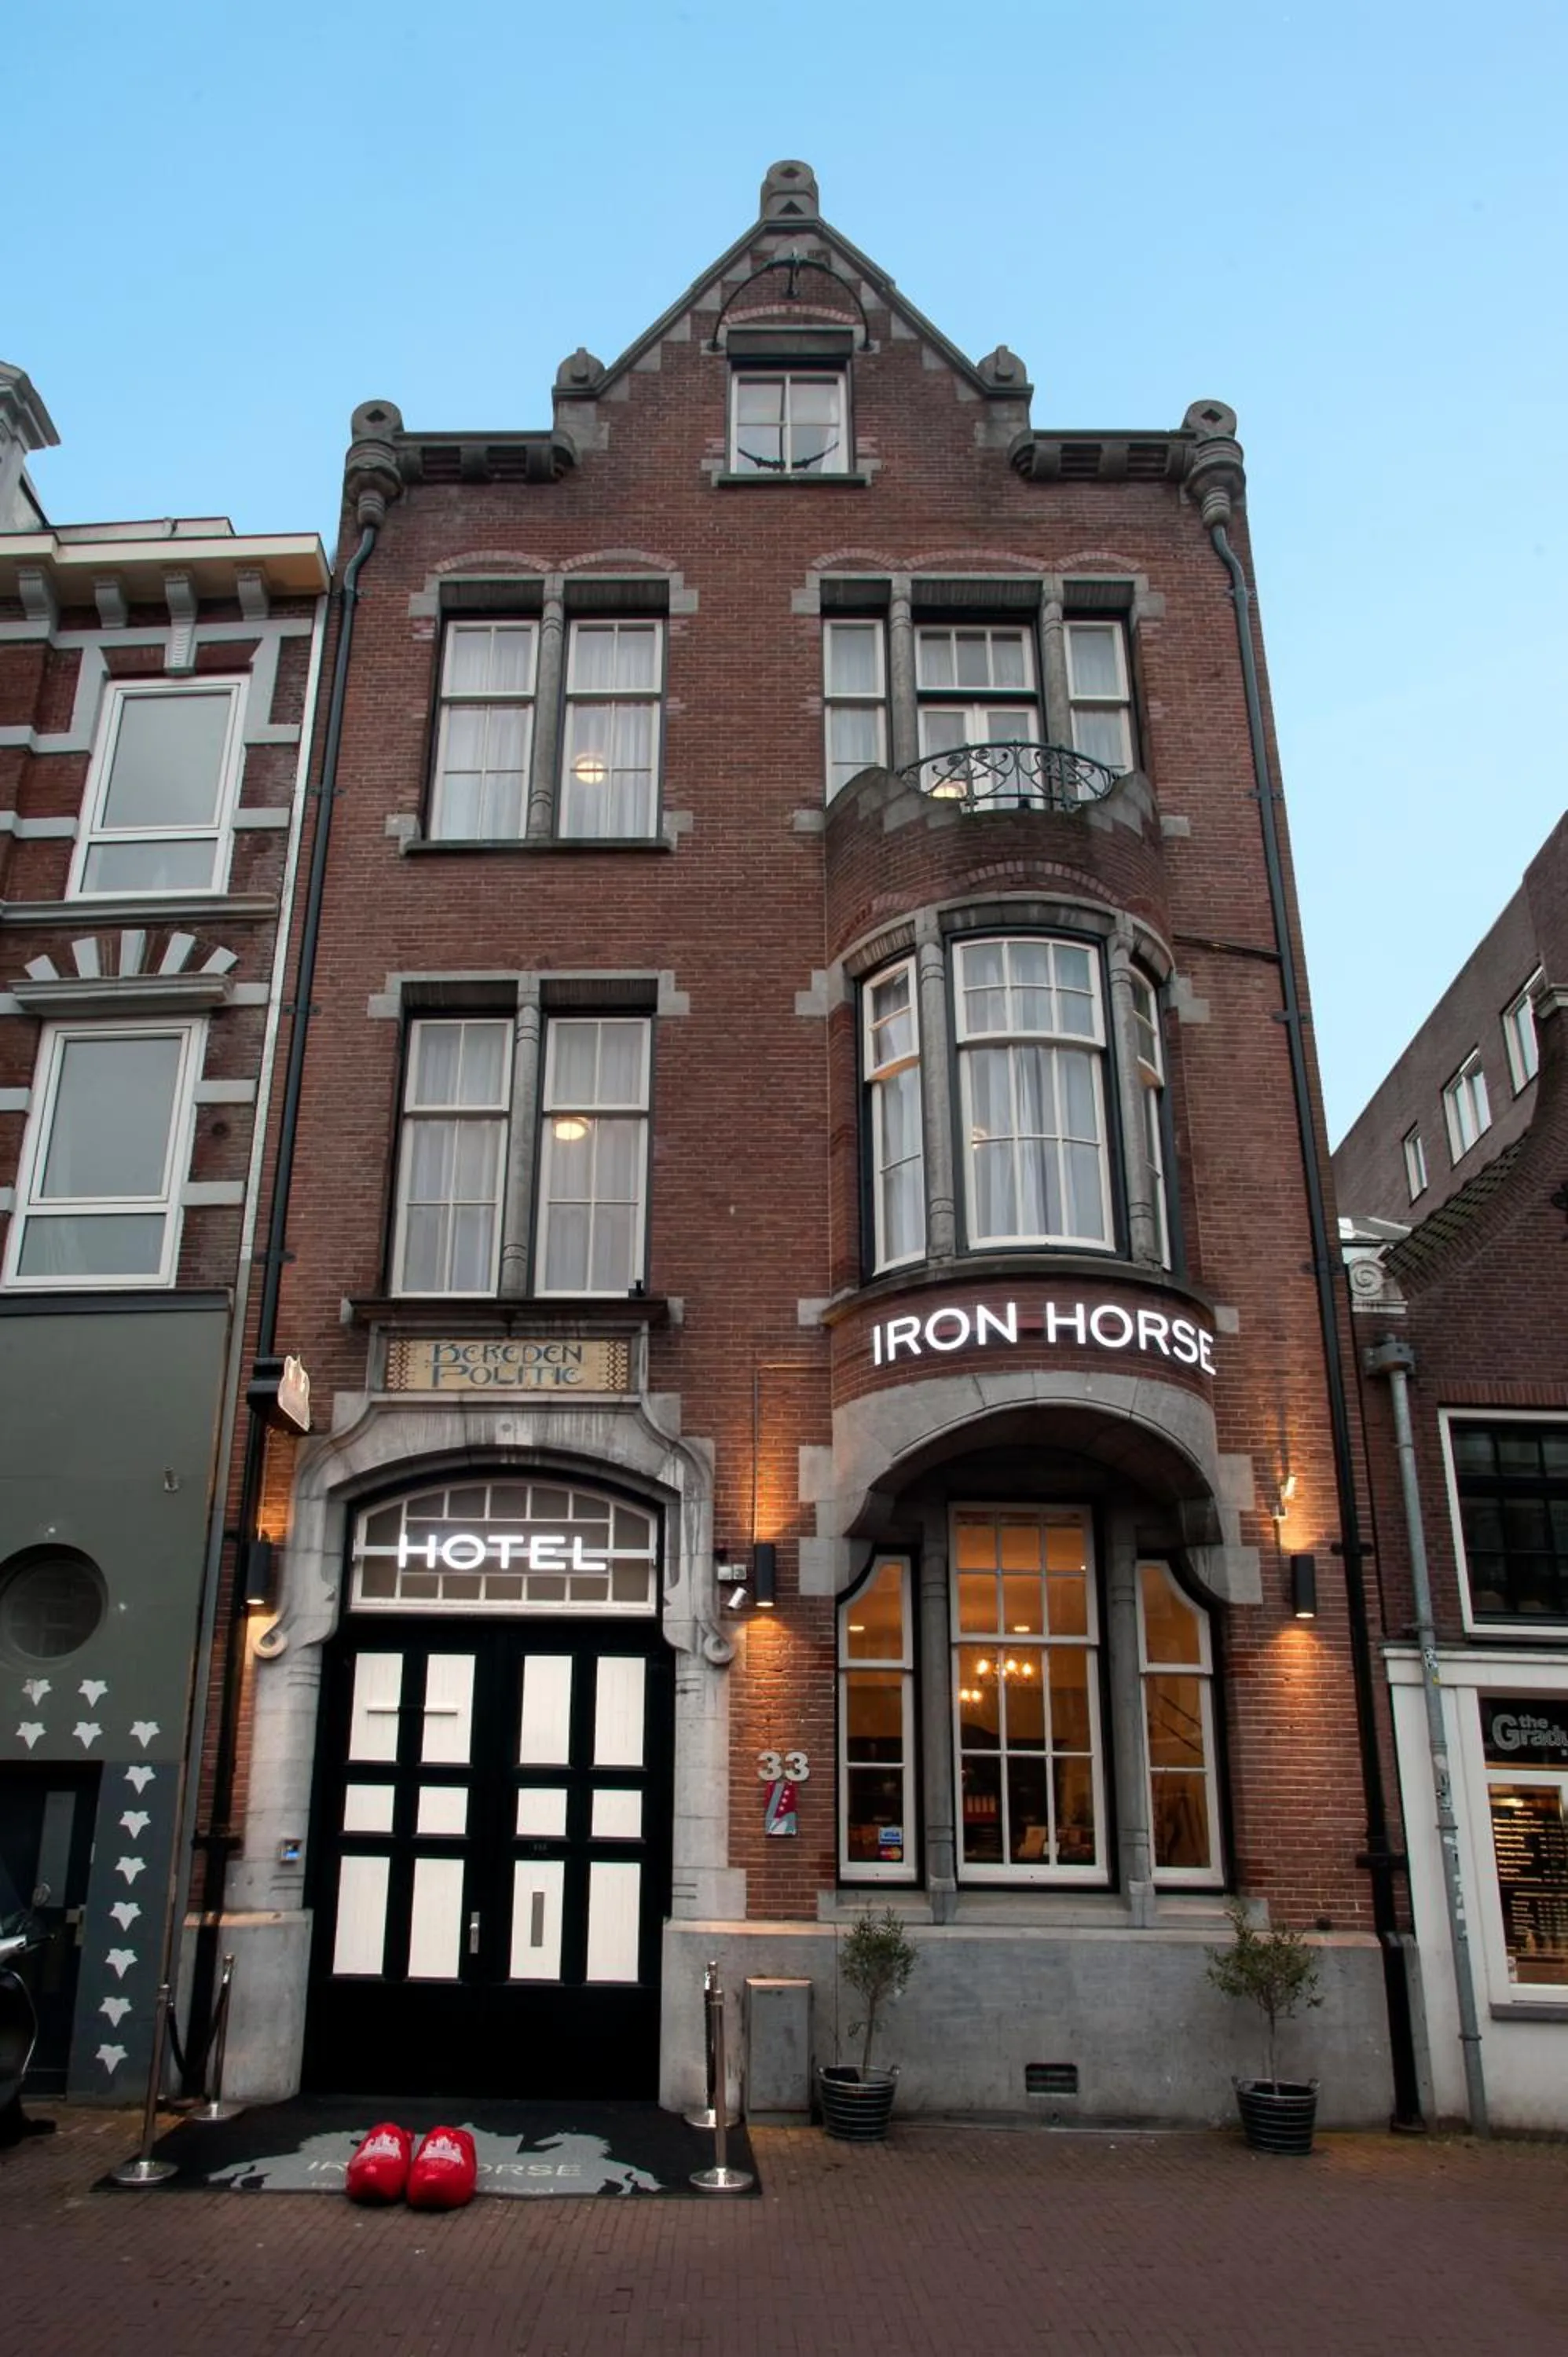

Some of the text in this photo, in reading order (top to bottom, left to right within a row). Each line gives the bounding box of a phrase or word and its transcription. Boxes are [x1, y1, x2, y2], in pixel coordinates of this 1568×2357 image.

[872, 1301, 1218, 1376] IRON HORSE
[429, 1343, 582, 1364] BEREDEN
[432, 1364, 584, 1387] POLITIE
[397, 1533, 607, 1571] HOTEL
[1518, 1714, 1549, 1728] the
[757, 1750, 811, 1782] 33
